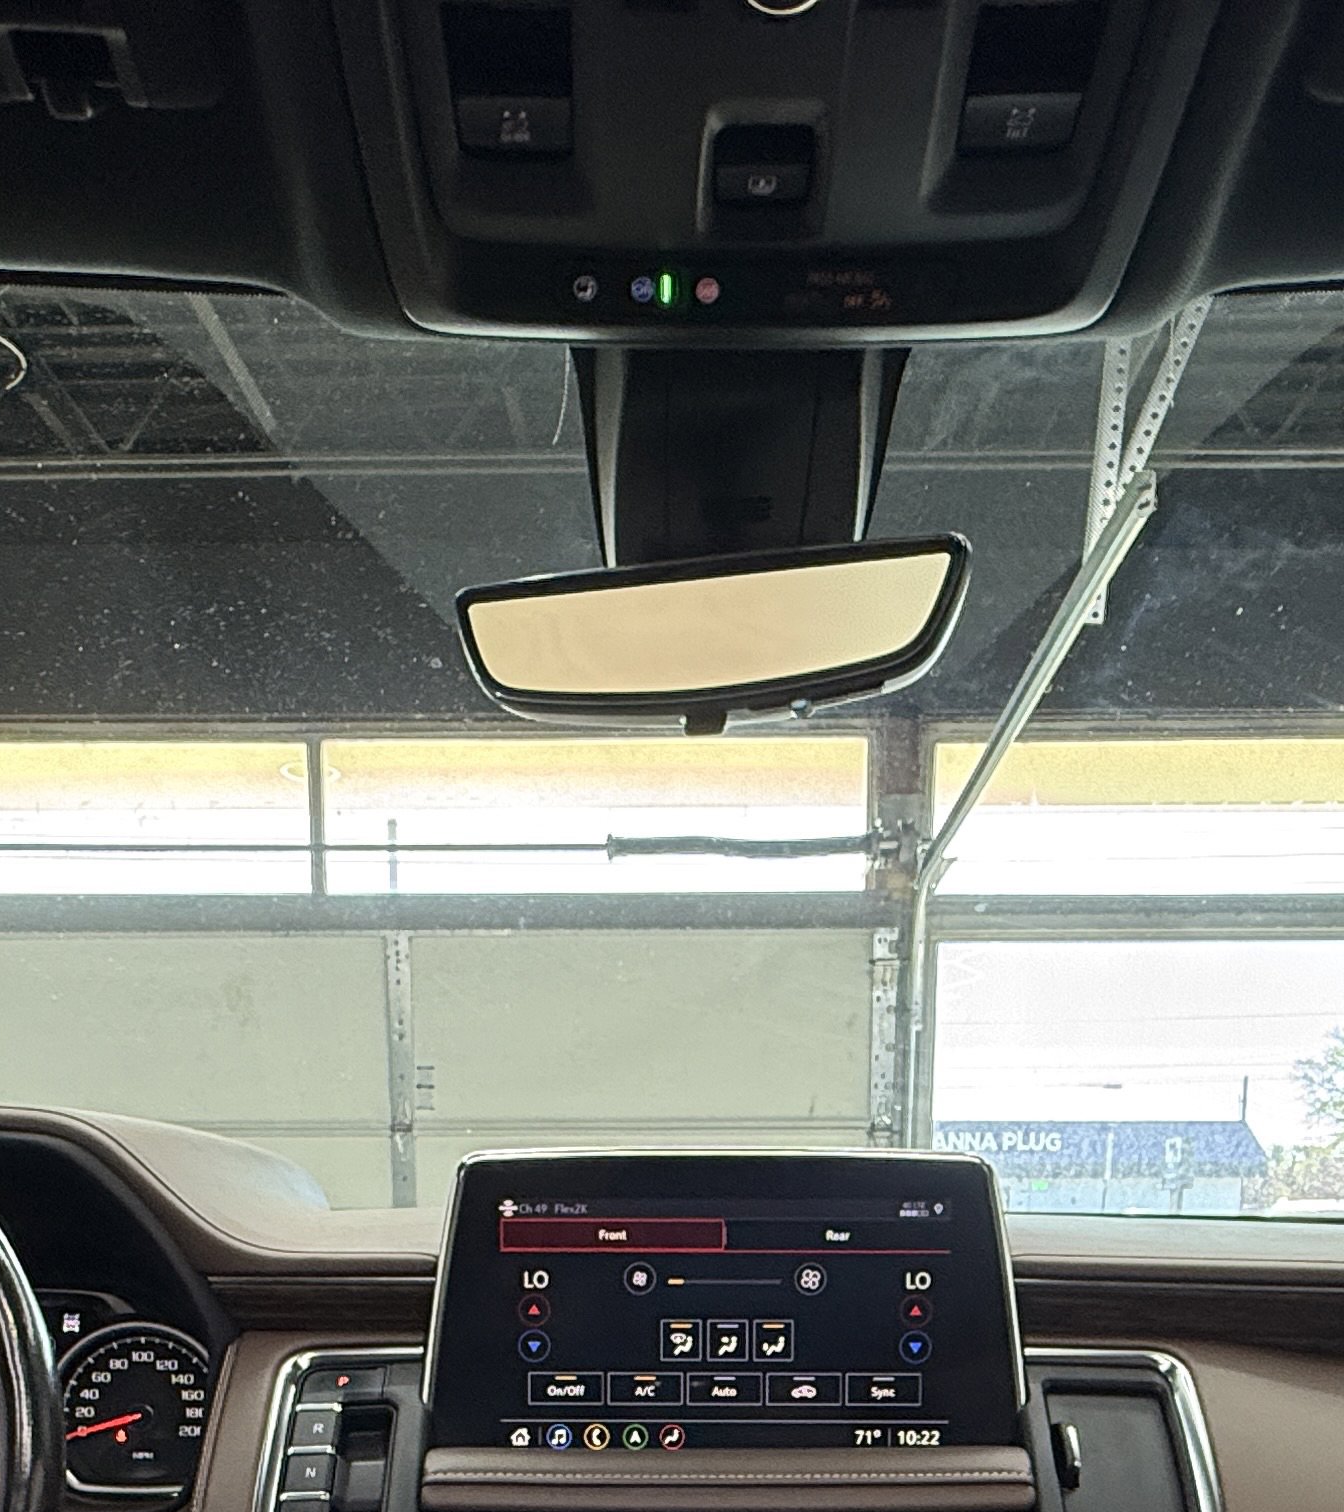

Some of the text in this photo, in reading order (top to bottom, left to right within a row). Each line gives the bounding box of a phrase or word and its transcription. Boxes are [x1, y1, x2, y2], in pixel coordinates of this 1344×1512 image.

[1002, 1131, 1062, 1152] PLUG
[535, 1204, 548, 1214] 49
[598, 1230, 627, 1241] Front
[826, 1230, 850, 1241] Rear
[523, 1270, 549, 1289] LO
[906, 1271, 931, 1290] LO
[131, 1351, 154, 1362] 100
[109, 1359, 128, 1370] 80
[156, 1360, 178, 1370] 120
[91, 1372, 111, 1383] 60
[171, 1374, 194, 1385] 140
[80, 1389, 99, 1399] 40
[181, 1390, 204, 1401] 160
[547, 1386, 585, 1396] On/Off
[634, 1386, 655, 1397] A/C
[711, 1387, 737, 1397] Auto
[870, 1387, 896, 1400] Sync
[75, 1407, 94, 1418] 20
[313, 1423, 324, 1434] R
[897, 1431, 940, 1446] 10:22
[306, 1467, 316, 1478] N
